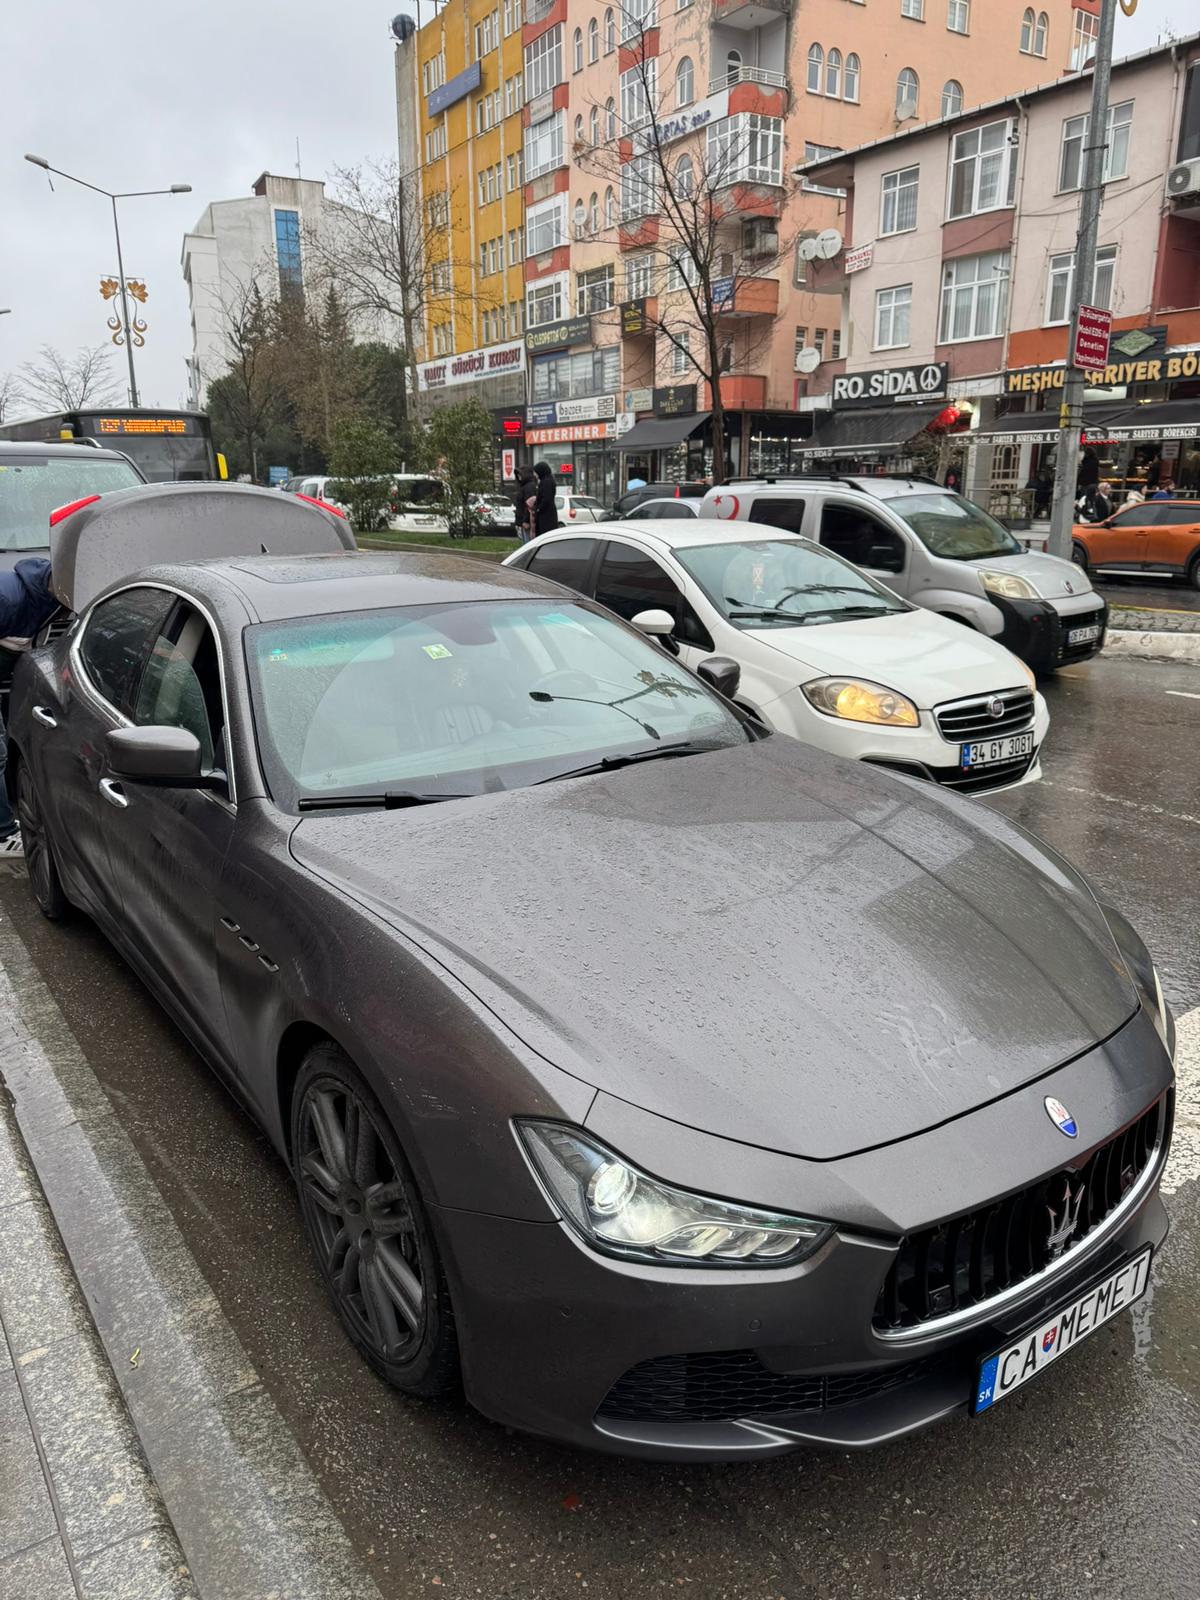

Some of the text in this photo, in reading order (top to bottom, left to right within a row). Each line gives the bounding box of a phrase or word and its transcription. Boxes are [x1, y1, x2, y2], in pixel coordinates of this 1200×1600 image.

[1091, 327, 1103, 338] EDS
[1079, 337, 1105, 352] Denetim
[424, 364, 447, 381] UMUT
[451, 351, 485, 377] SÜRÜCÜ
[488, 346, 522, 368] KURSU
[1008, 370, 1065, 393] MEŞHU
[1167, 351, 1200, 378] BÖ
[532, 426, 599, 442] VETERİNER
[971, 744, 986, 763] 34
[990, 741, 1004, 759] GY
[1008, 735, 1031, 755] 3081
[1000, 1256, 1147, 1390] CA MEMET
[978, 1387, 993, 1403] SK
